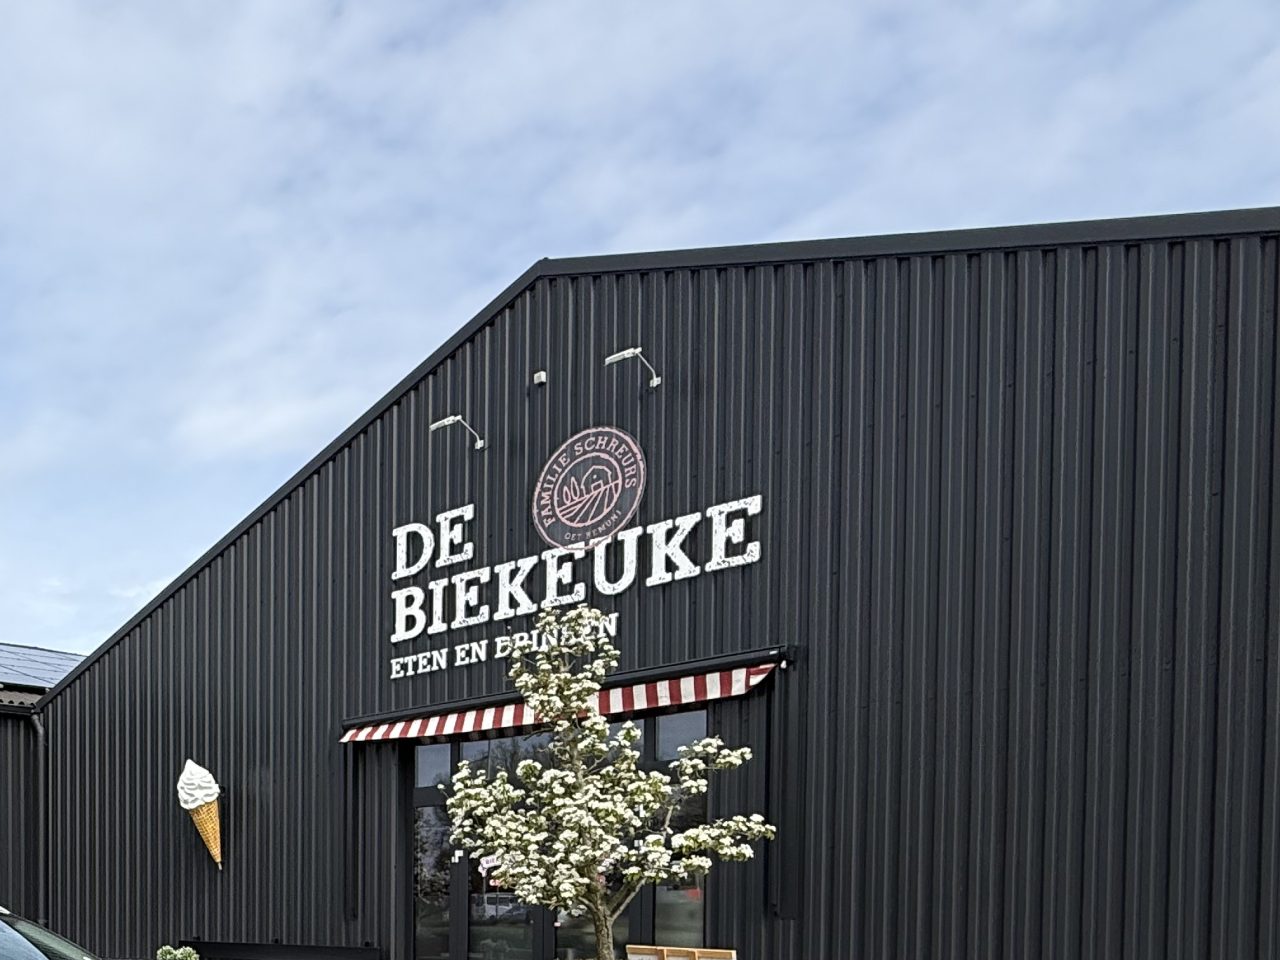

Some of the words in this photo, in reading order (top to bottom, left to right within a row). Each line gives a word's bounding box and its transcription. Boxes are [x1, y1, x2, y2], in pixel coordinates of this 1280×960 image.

[540, 453, 570, 528] FAMILIE
[573, 436, 637, 489] SCHREURS
[390, 494, 763, 644] BIEKEUKE
[391, 504, 475, 581] DE
[390, 647, 449, 680] ETEN
[454, 639, 488, 667] EN
